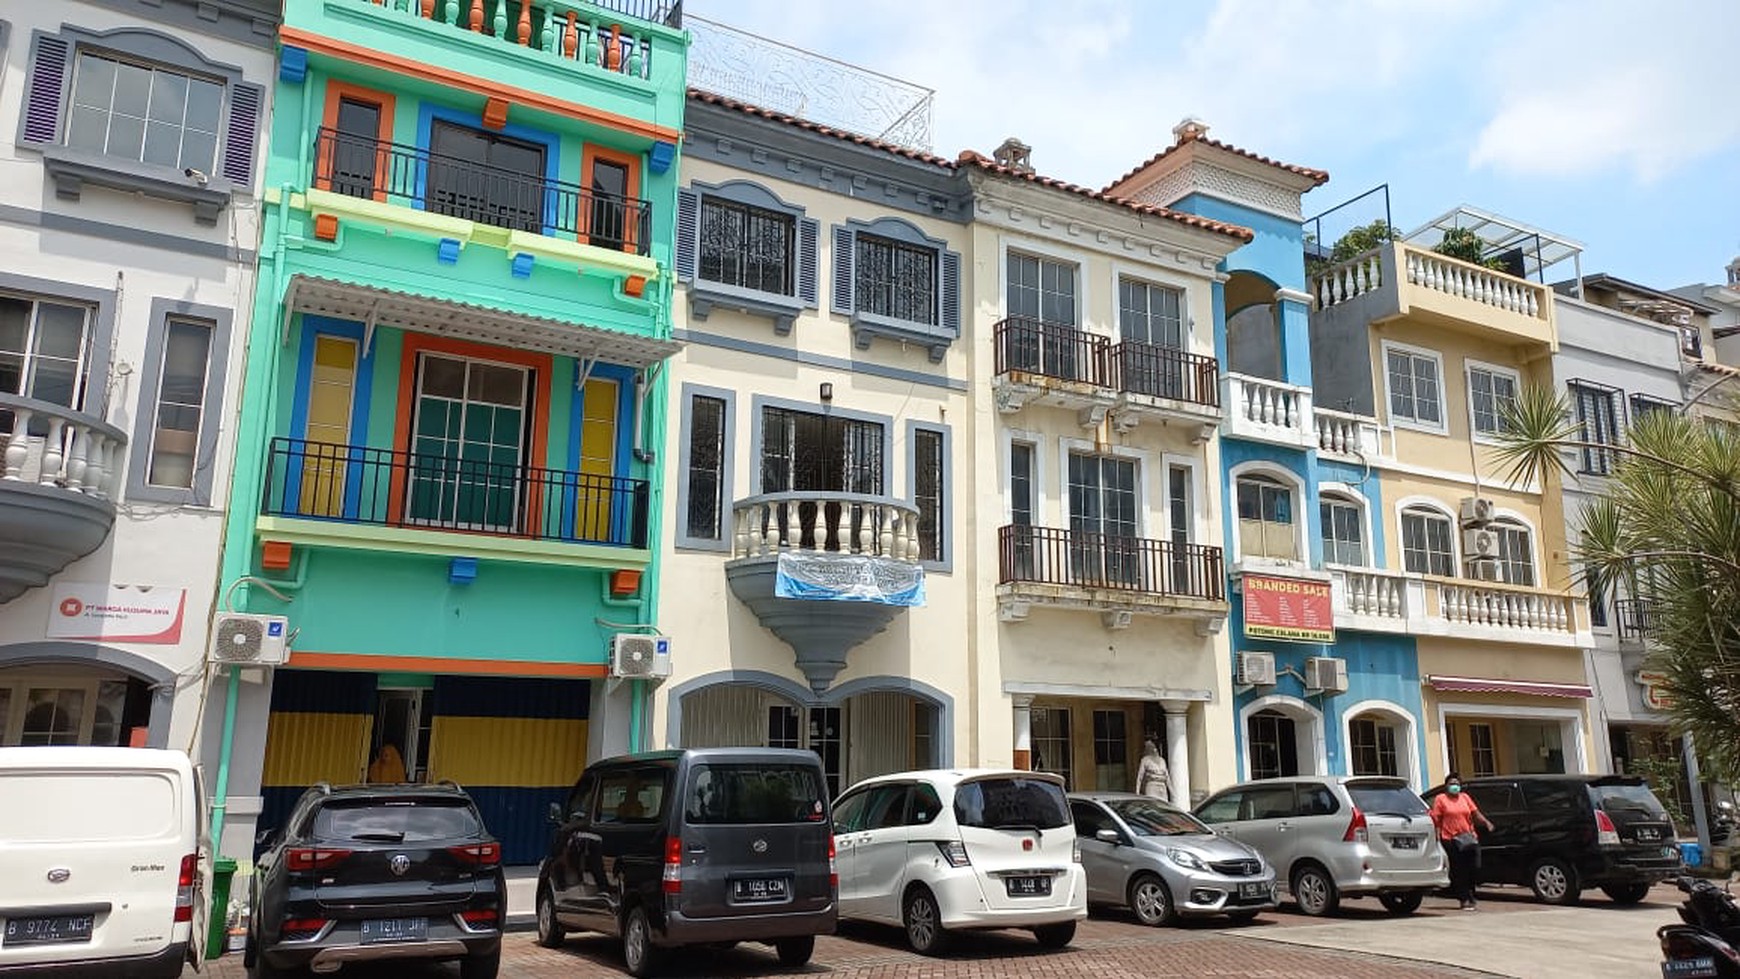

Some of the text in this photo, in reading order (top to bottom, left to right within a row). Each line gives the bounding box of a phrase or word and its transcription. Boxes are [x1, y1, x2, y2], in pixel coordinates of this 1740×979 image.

[1248, 578, 1329, 598] BRANDED SALE
[8, 922, 17, 935] B
